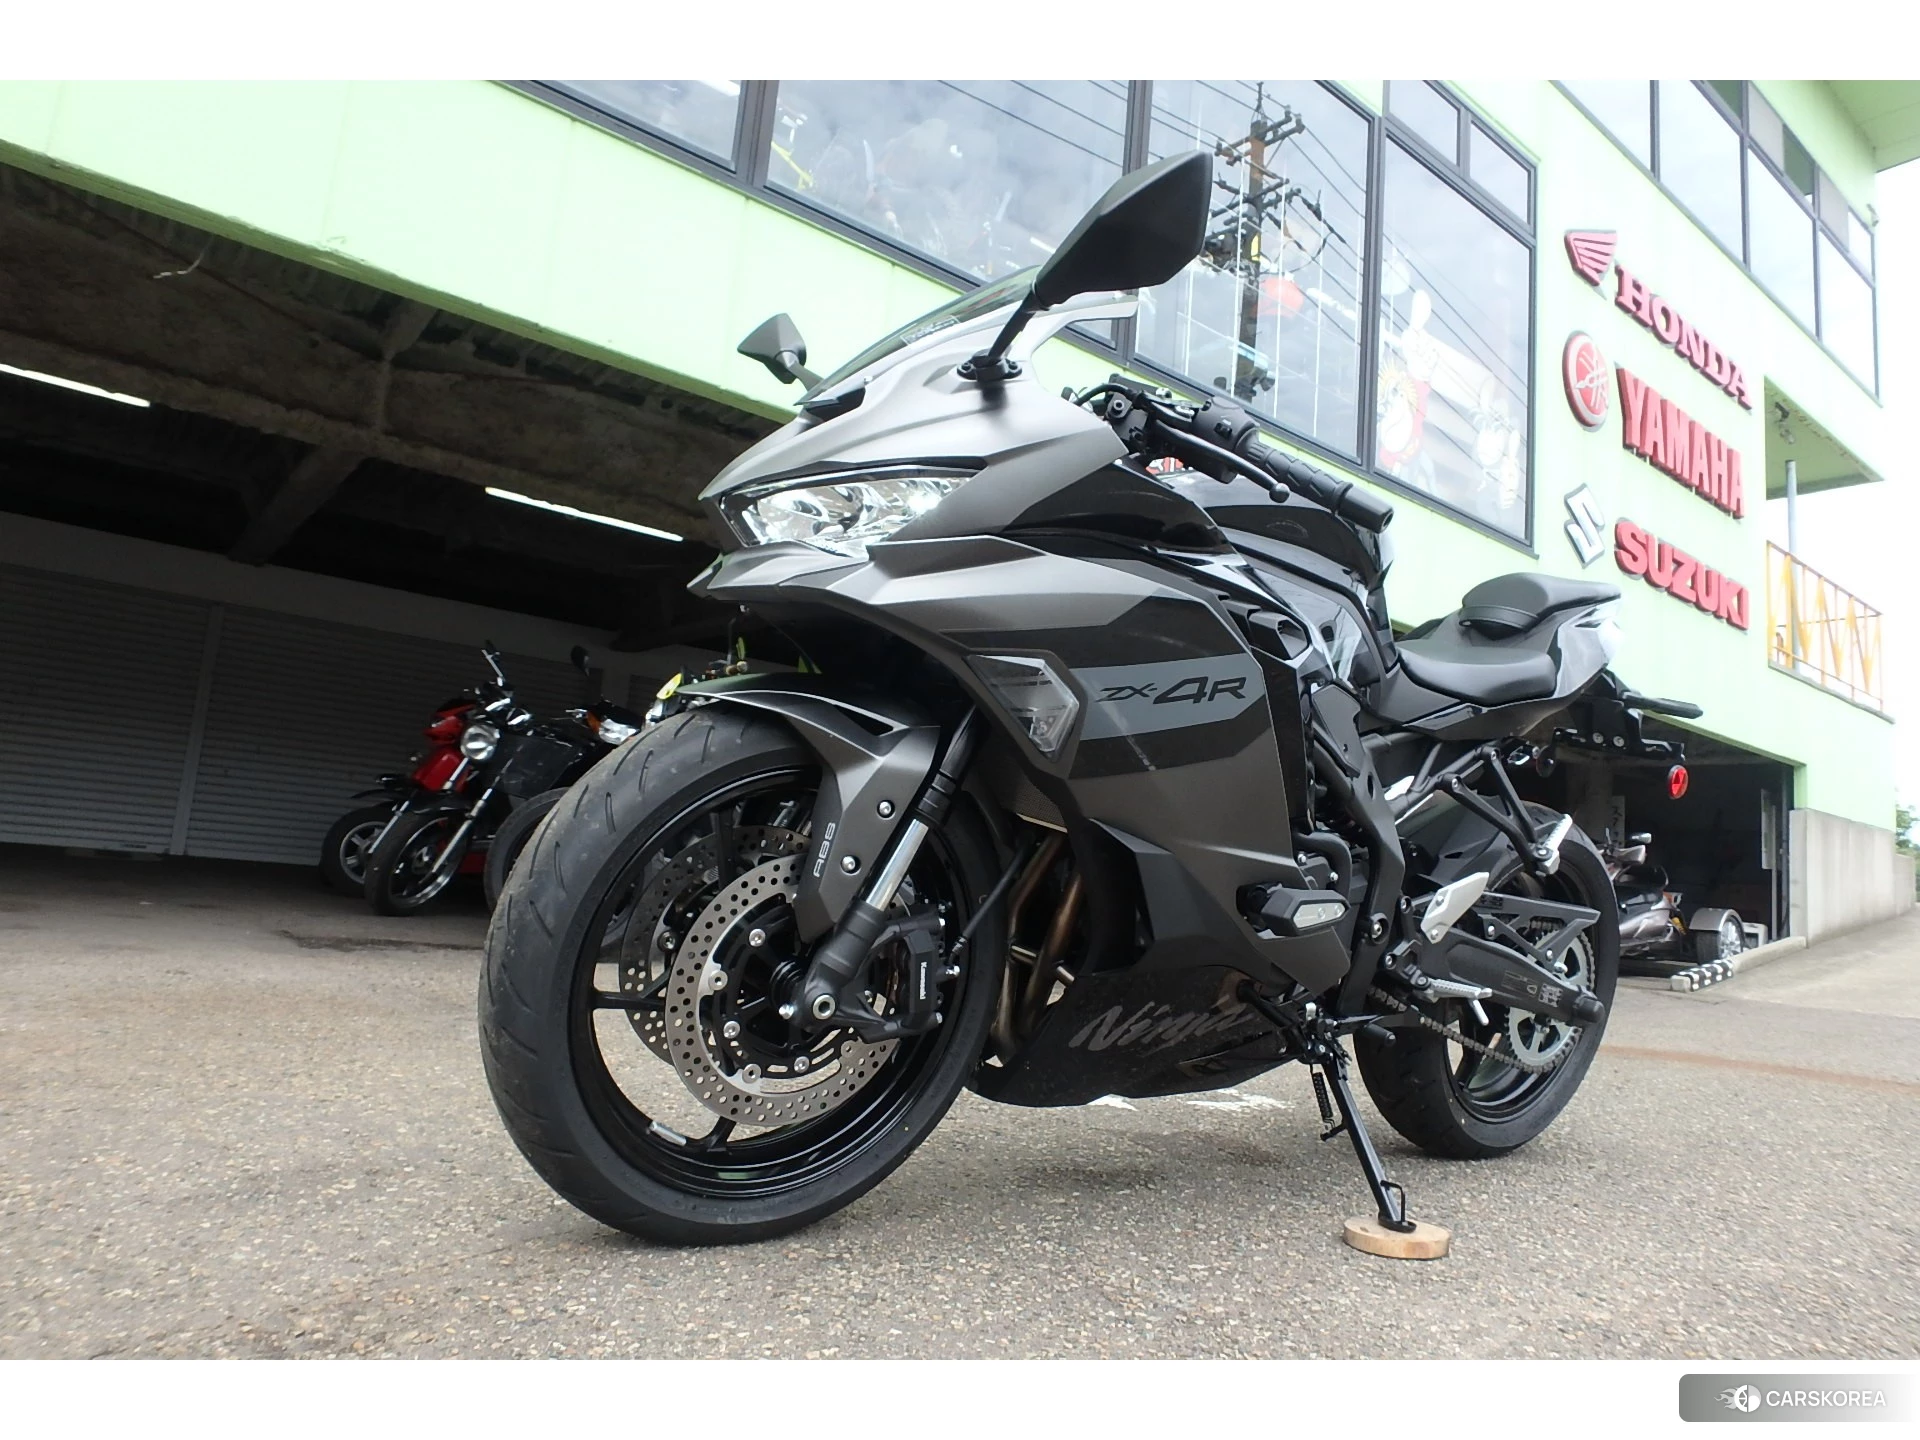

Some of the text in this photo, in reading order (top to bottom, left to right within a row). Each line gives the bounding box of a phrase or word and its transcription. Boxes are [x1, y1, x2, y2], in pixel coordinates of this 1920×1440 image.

[1614, 262, 1752, 411] HONDA
[1615, 364, 1745, 520] YAMAHA
[1614, 518, 1749, 631] SUZUKI
[1096, 675, 1247, 705] ZX-4R
[812, 821, 837, 878] ABS
